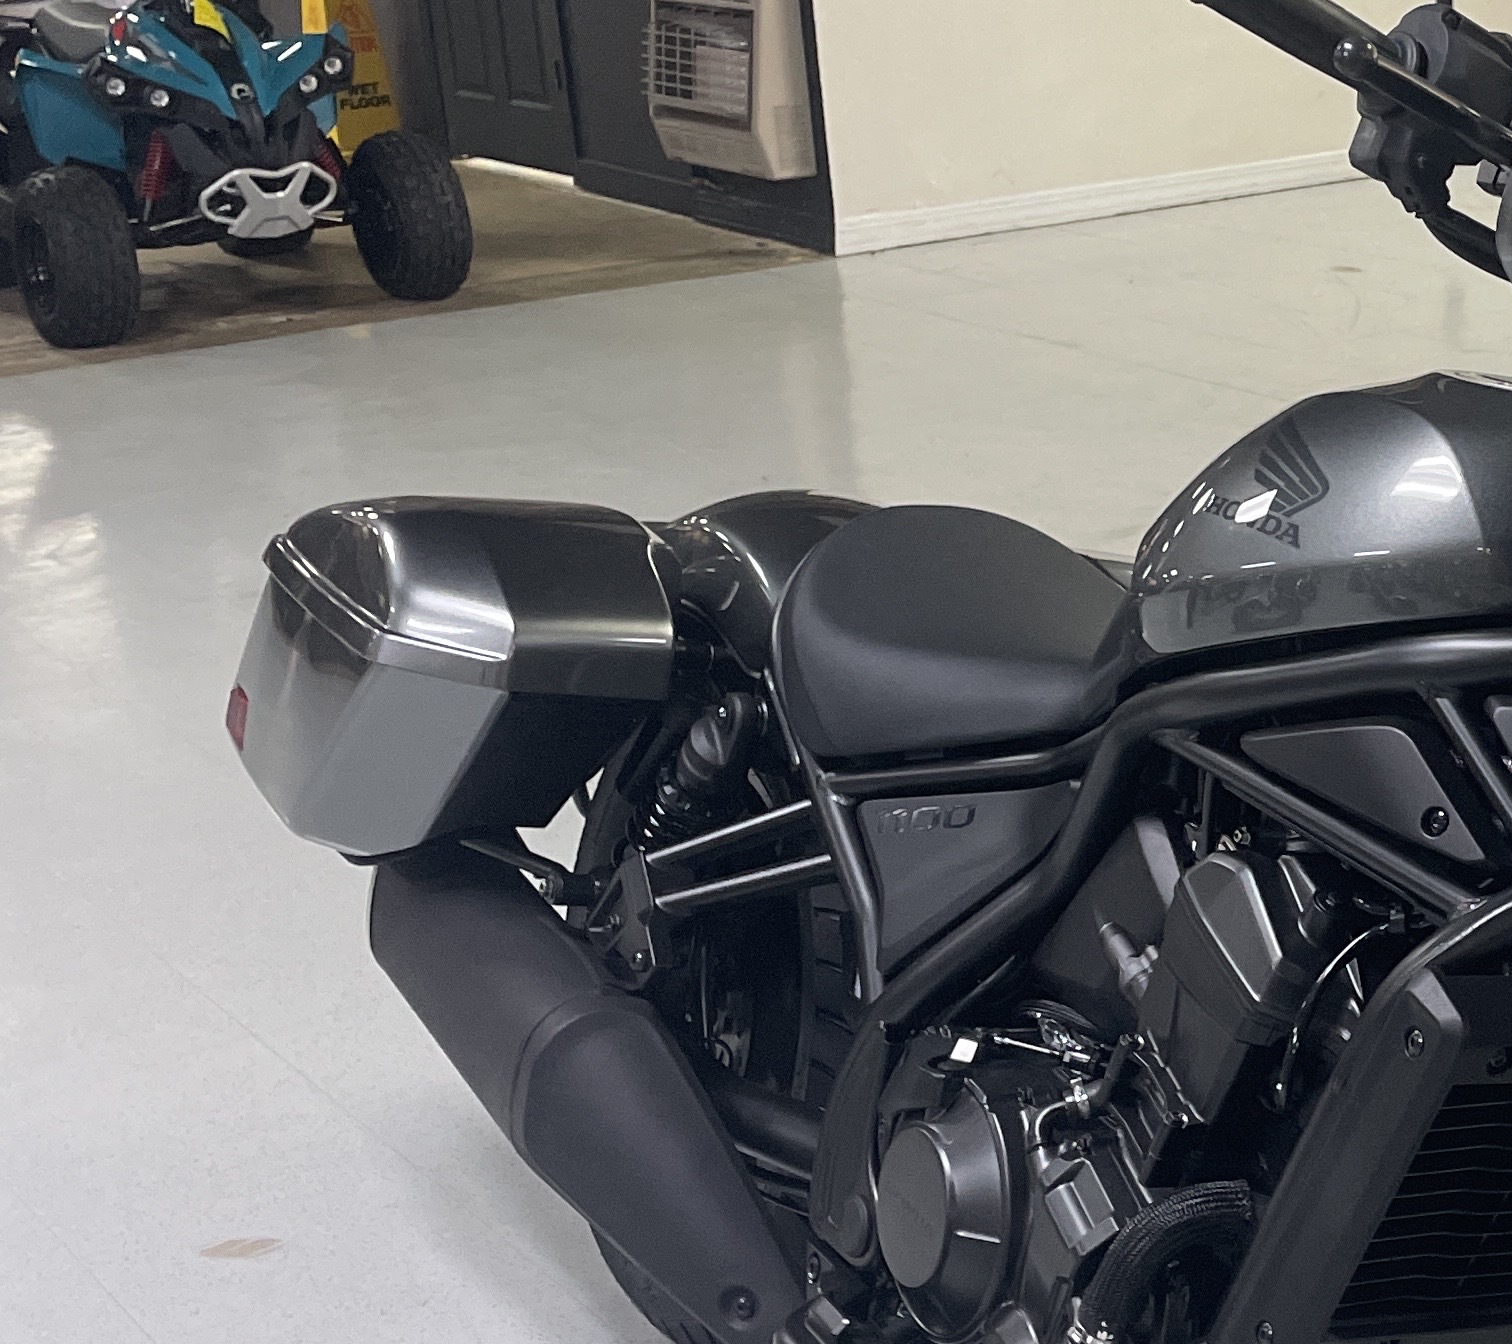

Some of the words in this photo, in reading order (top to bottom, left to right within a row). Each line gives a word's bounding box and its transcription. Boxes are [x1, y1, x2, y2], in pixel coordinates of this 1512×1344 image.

[348, 82, 379, 95] WET
[340, 94, 391, 111] FLOOR
[1203, 494, 1301, 549] HODA
